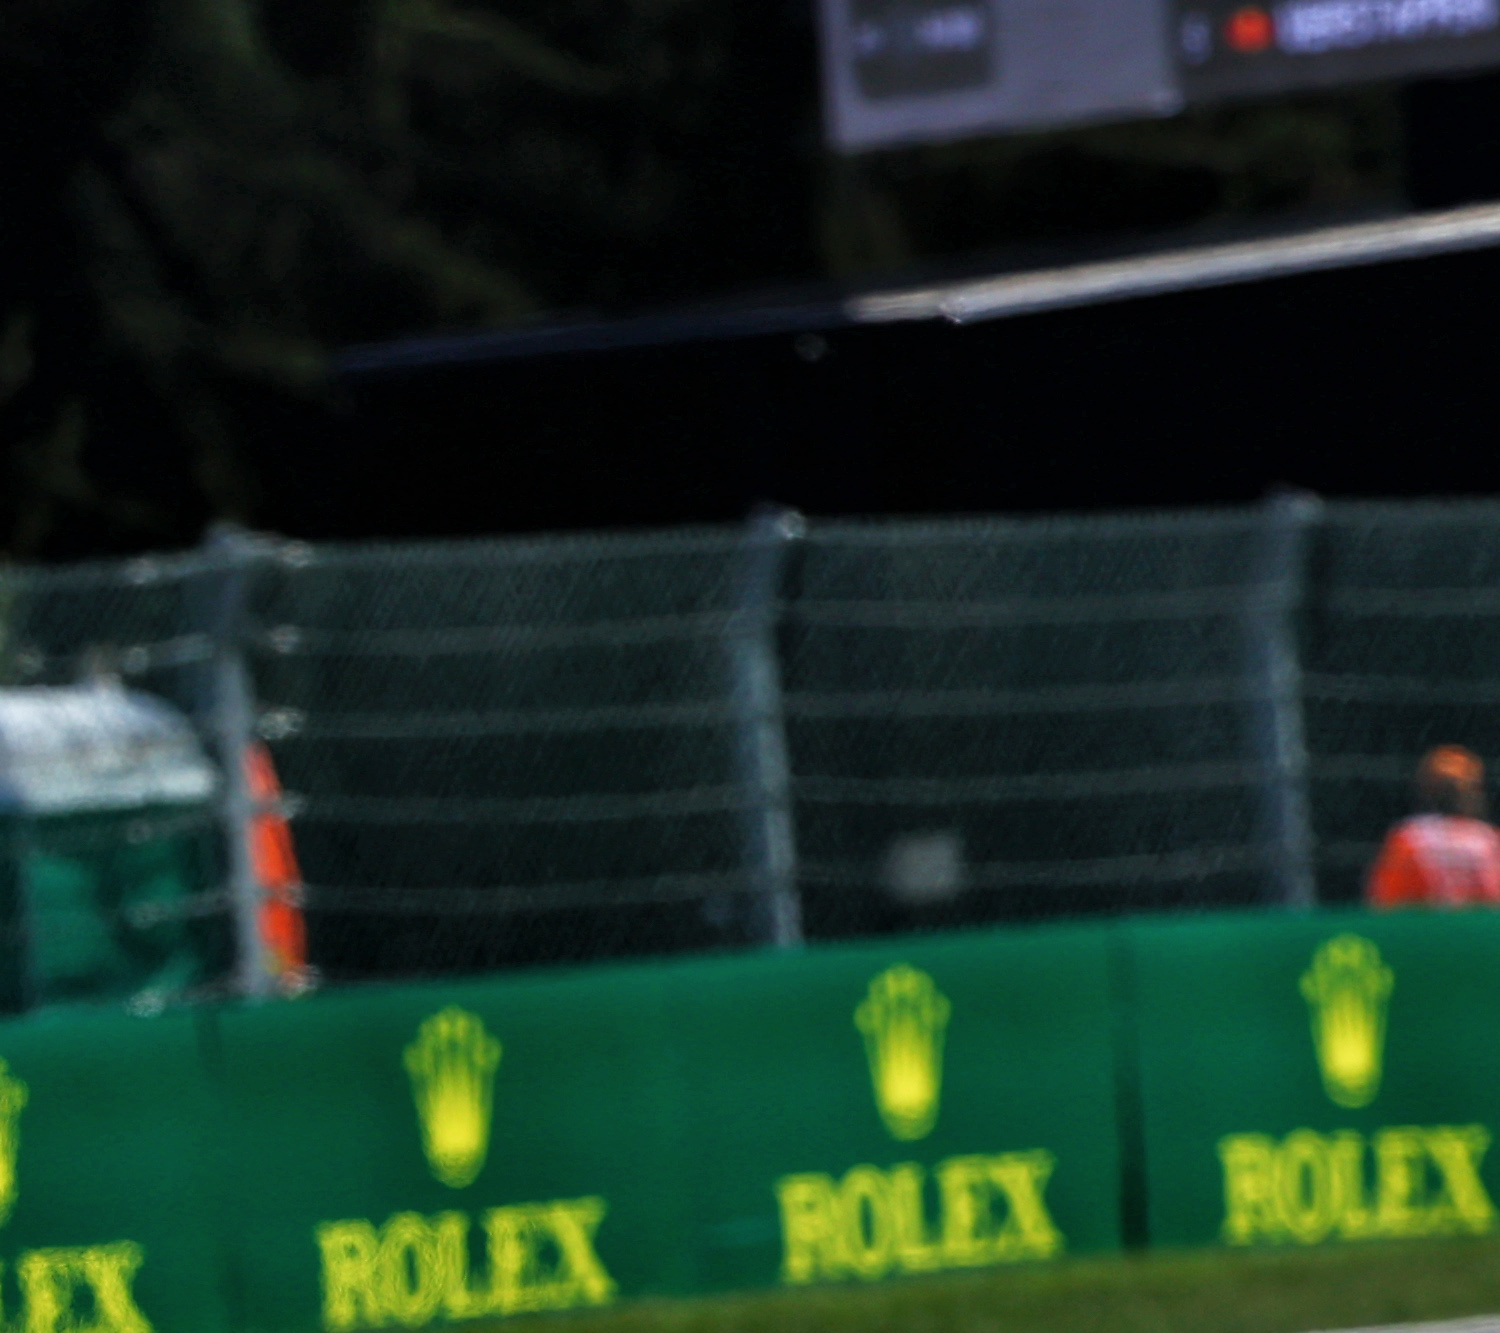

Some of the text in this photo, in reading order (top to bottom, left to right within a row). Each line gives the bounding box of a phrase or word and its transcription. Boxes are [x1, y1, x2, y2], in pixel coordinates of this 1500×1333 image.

[777, 1153, 1059, 1283] ROLEX
[1221, 1126, 1495, 1246] ROLEX
[317, 1200, 612, 1332] ROLEX
